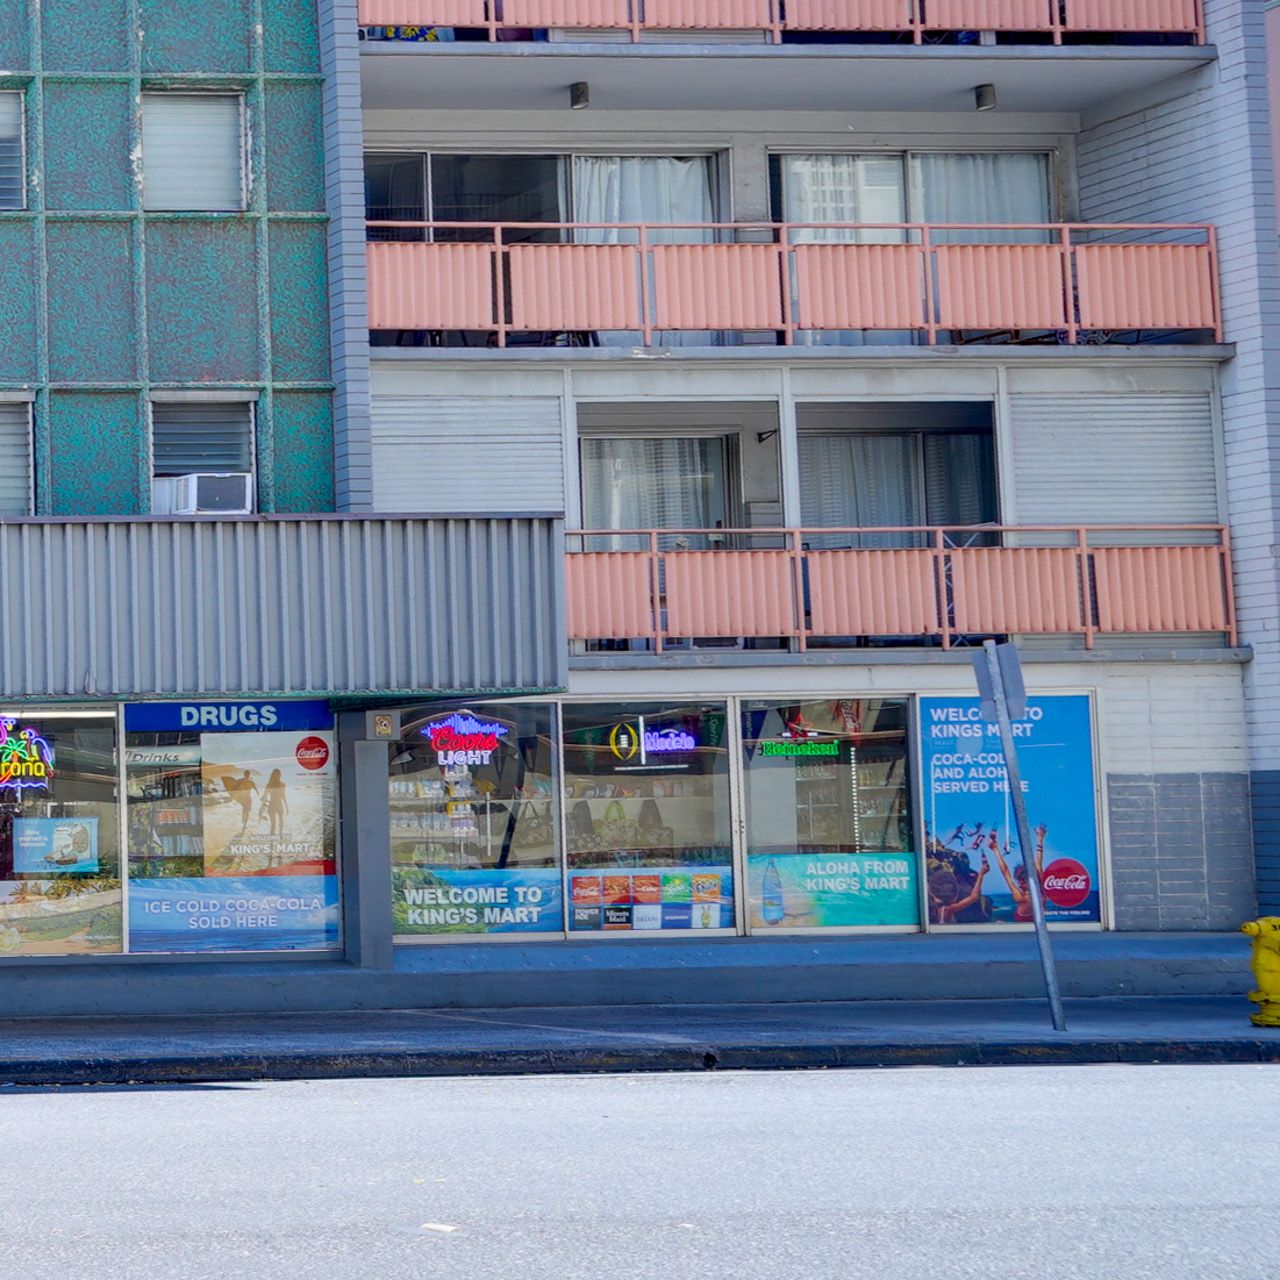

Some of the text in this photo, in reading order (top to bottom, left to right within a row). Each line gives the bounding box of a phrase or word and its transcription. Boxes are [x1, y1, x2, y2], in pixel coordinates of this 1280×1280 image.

[181, 705, 278, 726] DRUGS
[931, 723, 1034, 737] KINGS MRT
[430, 725, 499, 752] Coors
[762, 740, 839, 757] Heineken
[132, 752, 181, 763] Drinks
[932, 753, 1007, 765] COCA-COL
[933, 767, 1009, 779] AND ALOH
[934, 781, 1029, 793] SERVED HEE
[230, 842, 310, 854] KING'S MART
[807, 861, 909, 875] ALOHA FROM
[807, 876, 910, 891] KING'S MART
[403, 886, 542, 905] WELCOME TO
[144, 897, 322, 913] ICE COLD COCA-COLA
[189, 915, 278, 929] SOLD HERE
[408, 907, 542, 925] KING'S MART
